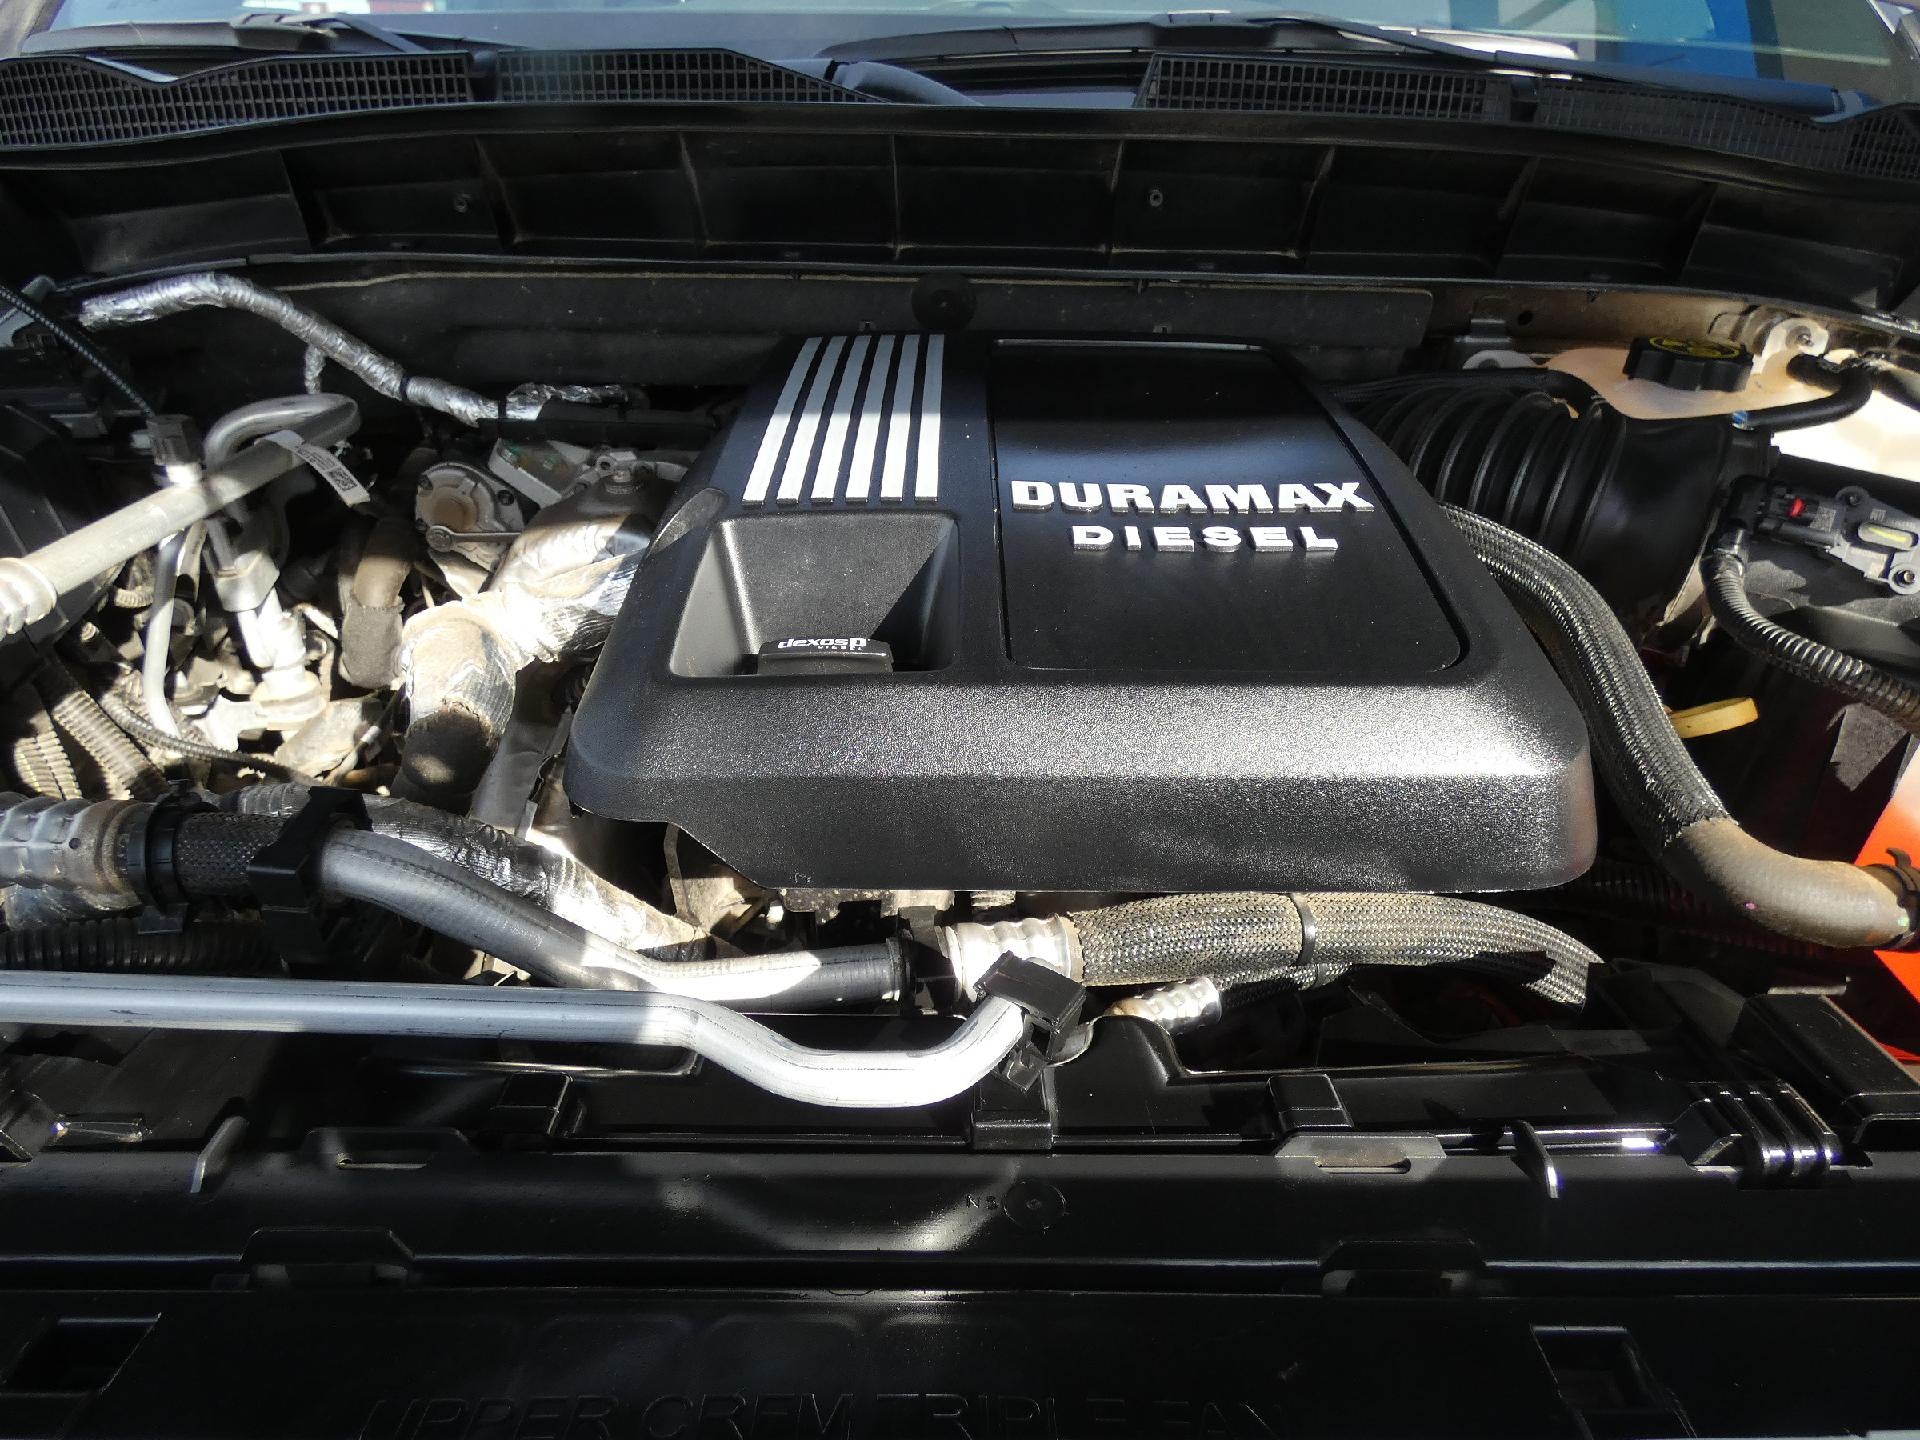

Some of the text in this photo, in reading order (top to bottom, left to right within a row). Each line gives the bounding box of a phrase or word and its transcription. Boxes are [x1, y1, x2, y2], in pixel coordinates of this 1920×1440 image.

[1011, 480, 1374, 513] DURAMAX
[1072, 525, 1338, 553] DIESEL
[358, 1393, 620, 1440] UPPER
